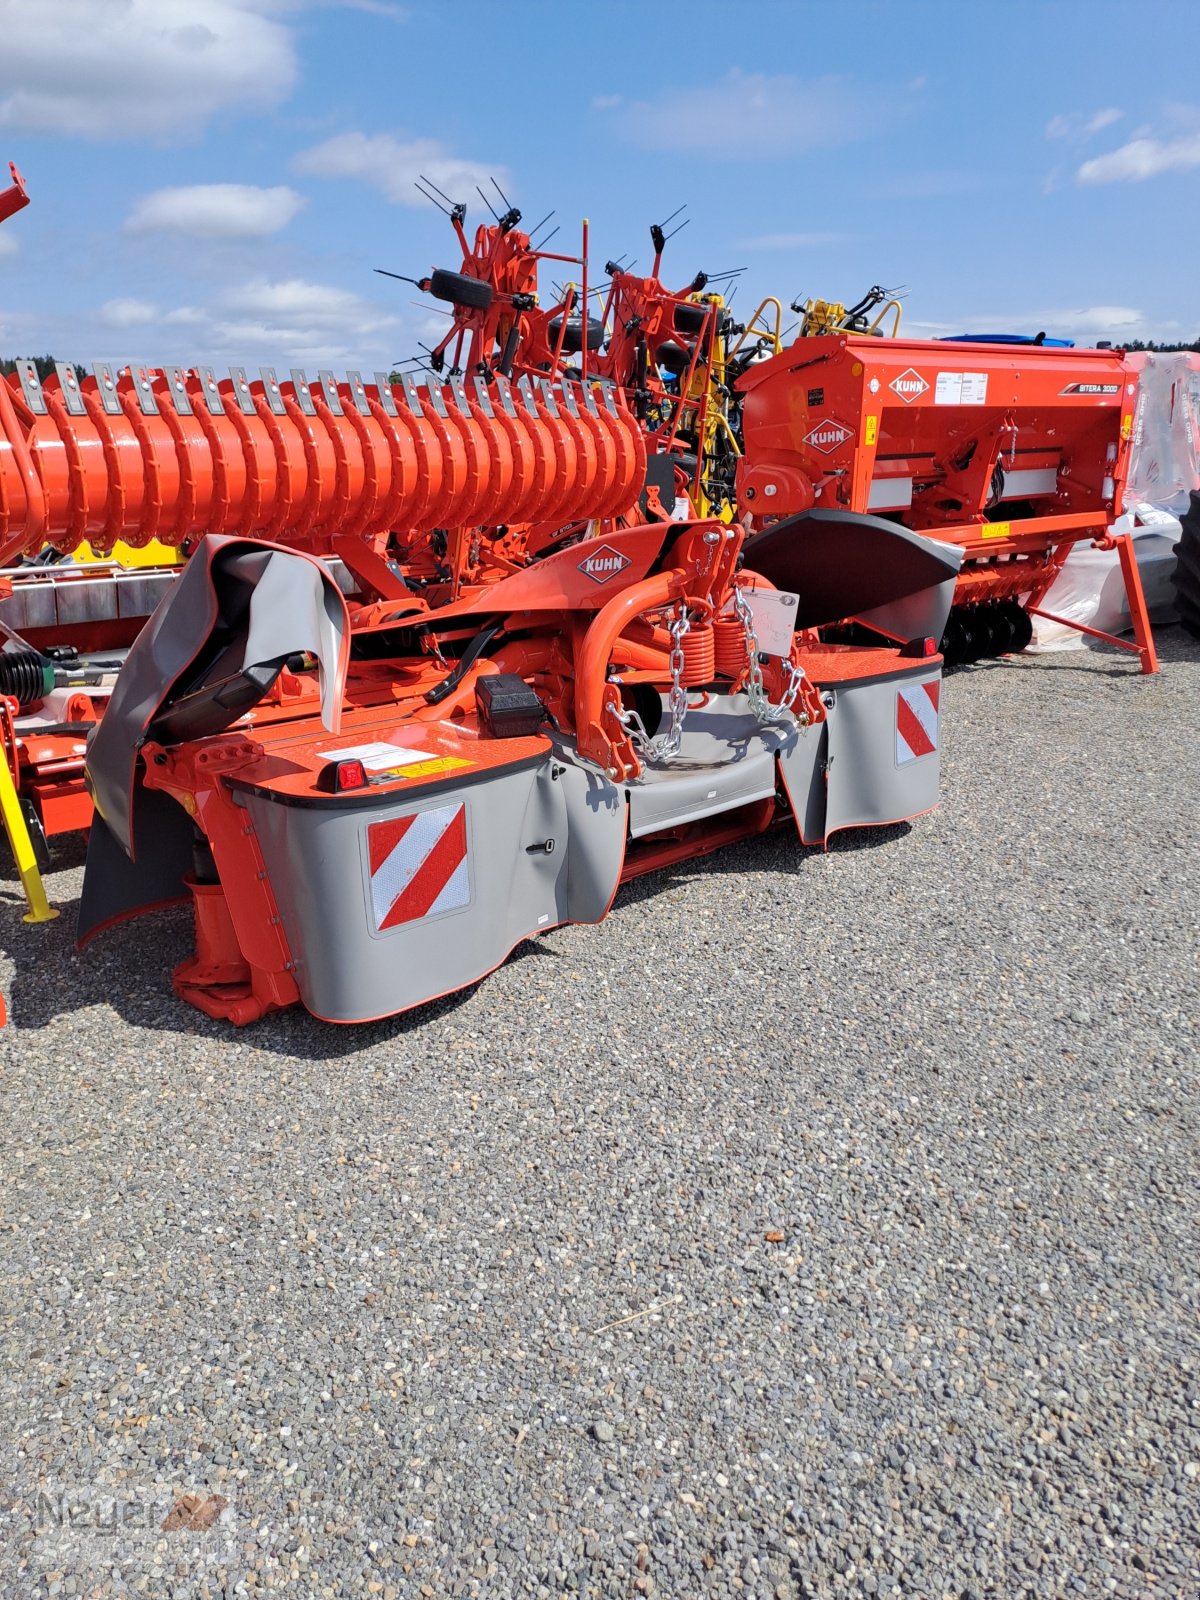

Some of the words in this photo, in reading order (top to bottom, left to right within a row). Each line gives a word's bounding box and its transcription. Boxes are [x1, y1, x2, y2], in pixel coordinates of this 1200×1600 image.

[896, 379, 923, 393] KUHN
[1079, 384, 1101, 392] BITERA
[1102, 385, 1118, 393] 3000
[811, 429, 845, 445] KUHN
[586, 556, 623, 572] KUHN
